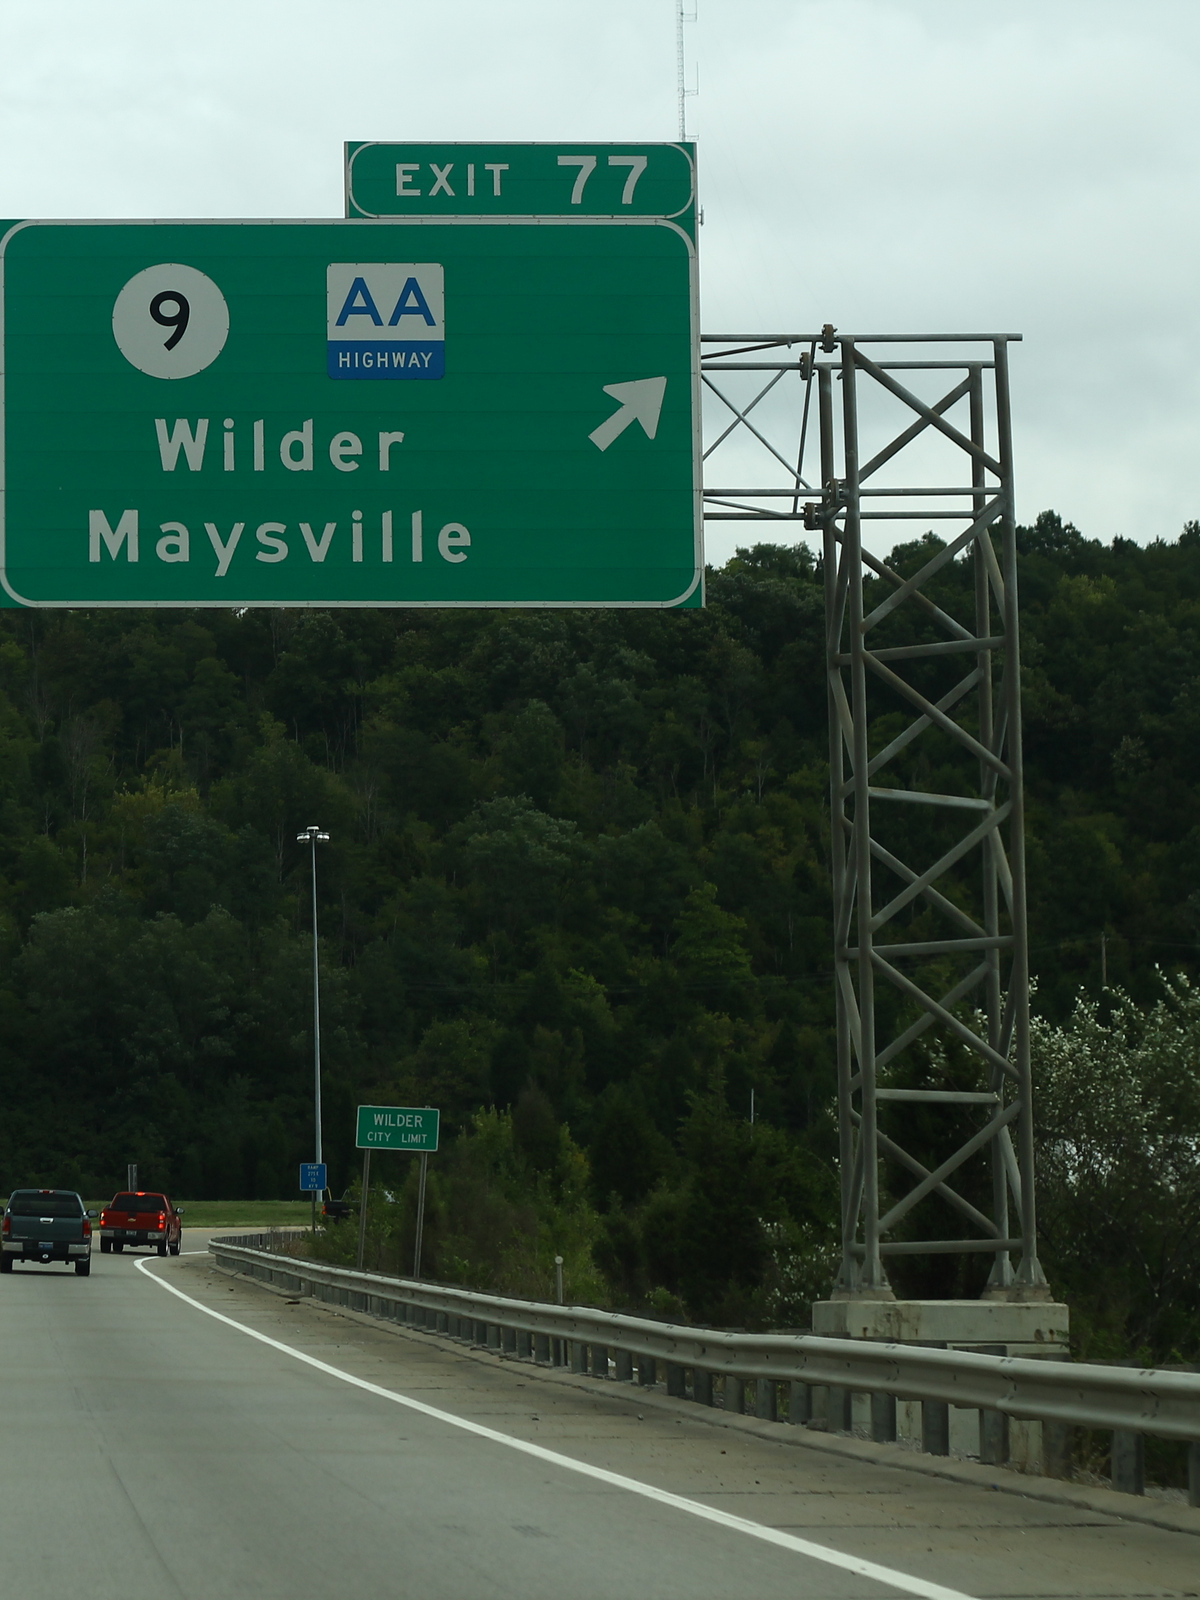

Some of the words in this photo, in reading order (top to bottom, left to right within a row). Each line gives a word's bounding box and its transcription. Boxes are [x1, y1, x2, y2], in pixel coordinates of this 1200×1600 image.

[395, 163, 510, 197] EXIT
[557, 155, 648, 205] 77
[148, 289, 191, 352] 9
[334, 276, 437, 327] AA
[339, 351, 433, 368] HIGHWAY
[154, 417, 405, 472] Wilder
[88, 509, 471, 577] Maysville
[367, 1131, 391, 1142] CITY
[401, 1133, 428, 1144] LIMIT
[373, 1113, 423, 1128] WILDER
